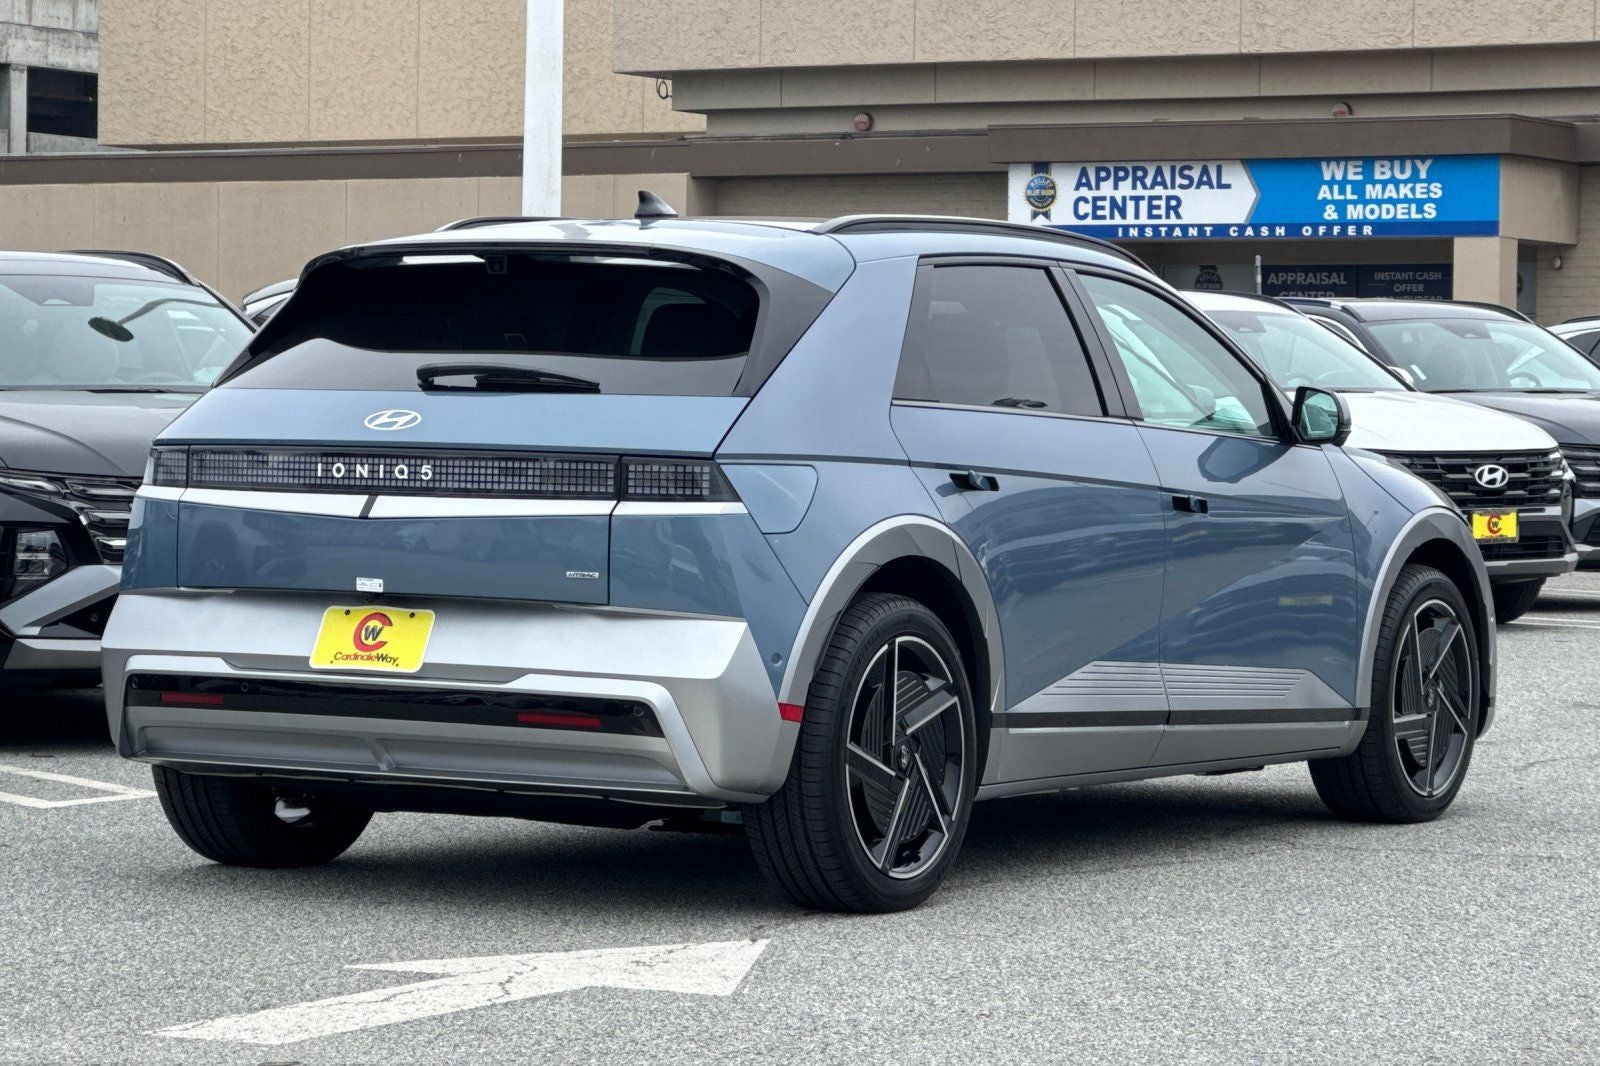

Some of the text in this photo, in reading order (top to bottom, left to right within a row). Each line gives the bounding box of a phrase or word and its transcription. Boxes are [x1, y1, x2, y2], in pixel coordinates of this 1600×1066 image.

[1074, 165, 1231, 191] APPRAISAL
[1321, 159, 1433, 181] WE BUY
[1317, 182, 1443, 201] ALL MAKES
[1073, 195, 1182, 220] CENTER
[1323, 202, 1437, 220] & MODELS
[1117, 225, 1373, 238] INSTANT CASH OFFER
[1267, 272, 1348, 286] APPRAISAL
[1374, 271, 1442, 281] INSTANT CASH
[1393, 283, 1425, 293] OFFER
[317, 462, 433, 480] IONIQ 5
[334, 651, 399, 665] CardinaleWay
